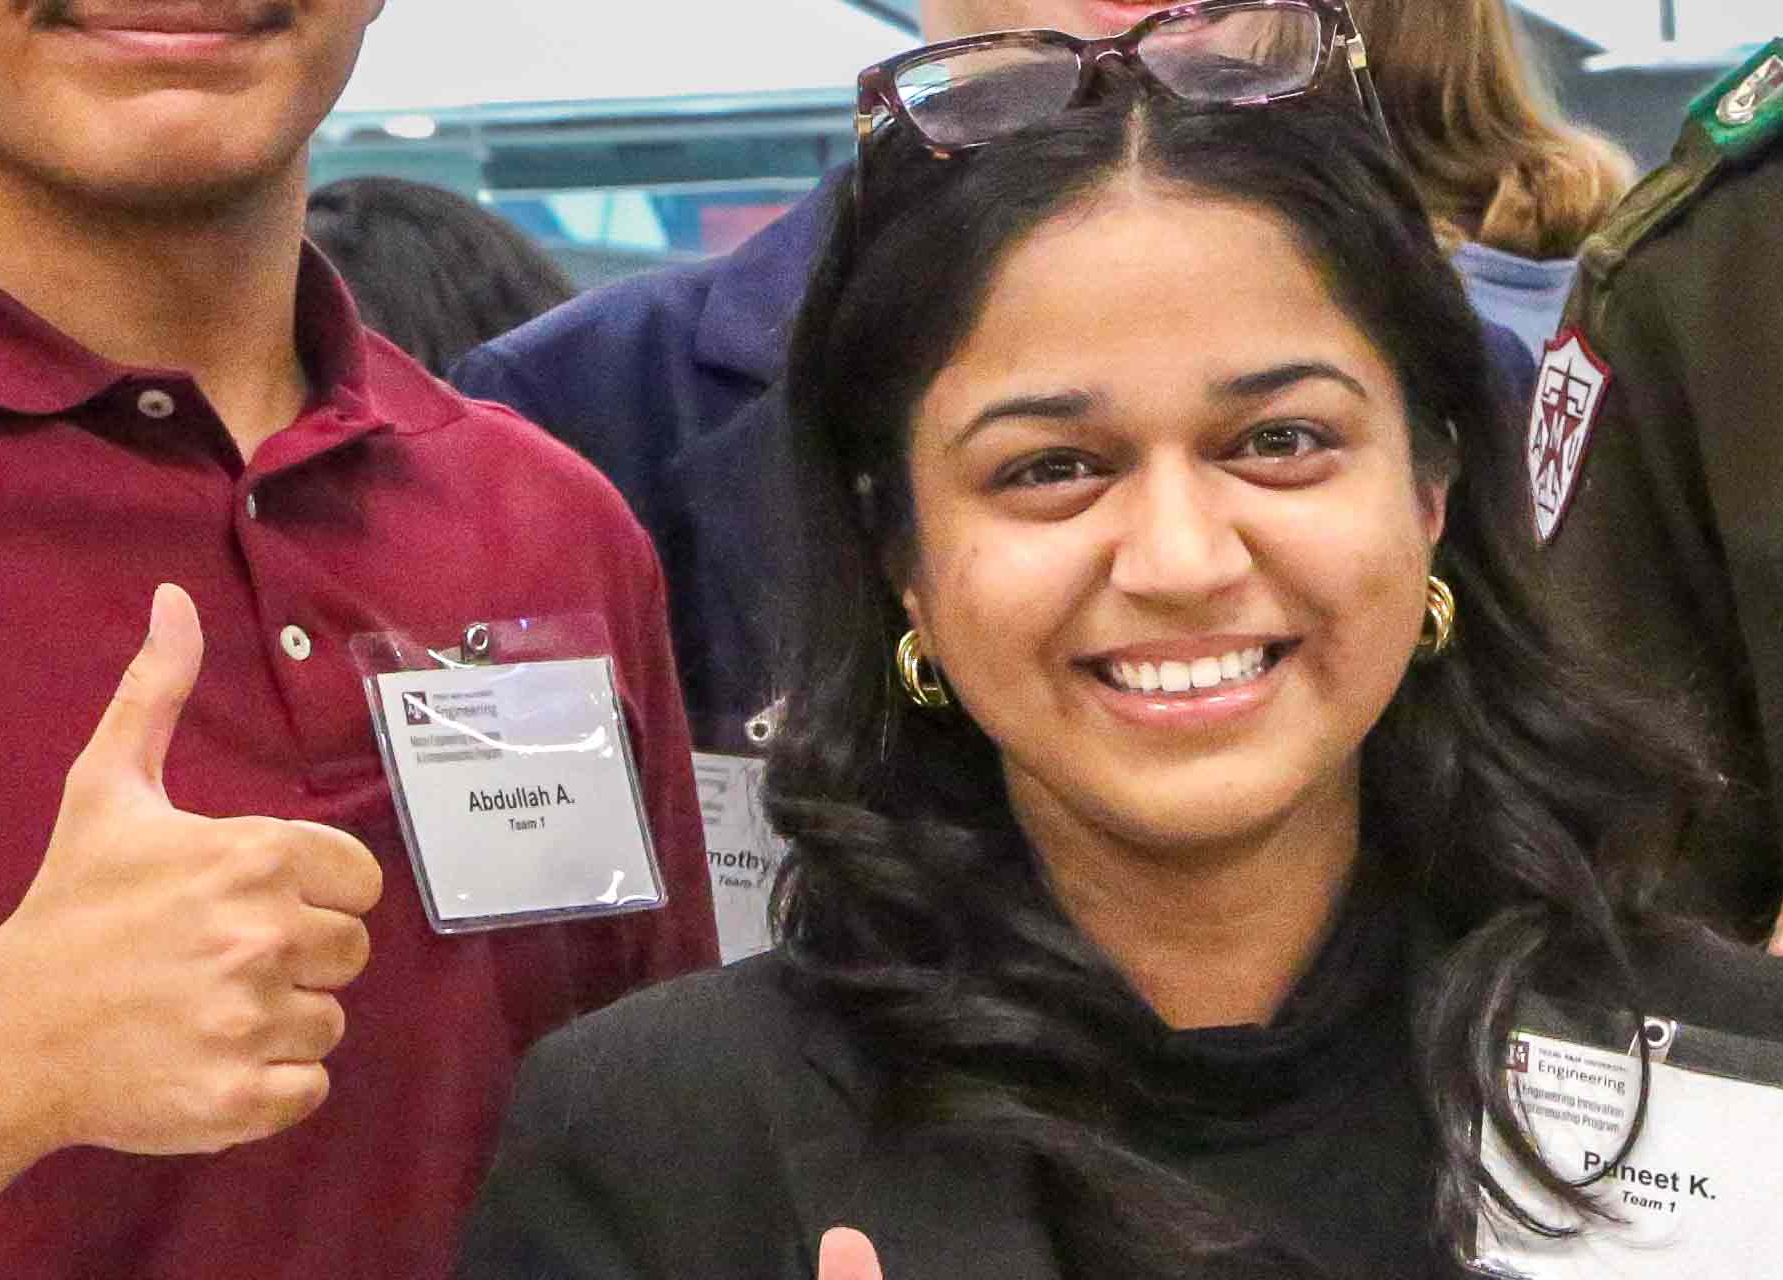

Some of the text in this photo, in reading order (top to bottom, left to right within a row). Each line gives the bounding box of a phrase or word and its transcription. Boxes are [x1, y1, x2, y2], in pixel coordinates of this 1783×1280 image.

[469, 783, 575, 812] Abdullah A.
[1538, 1059, 1625, 1095] Engineering
[1689, 1174, 1716, 1200] K.
[1622, 1190, 1676, 1213] Team 1
